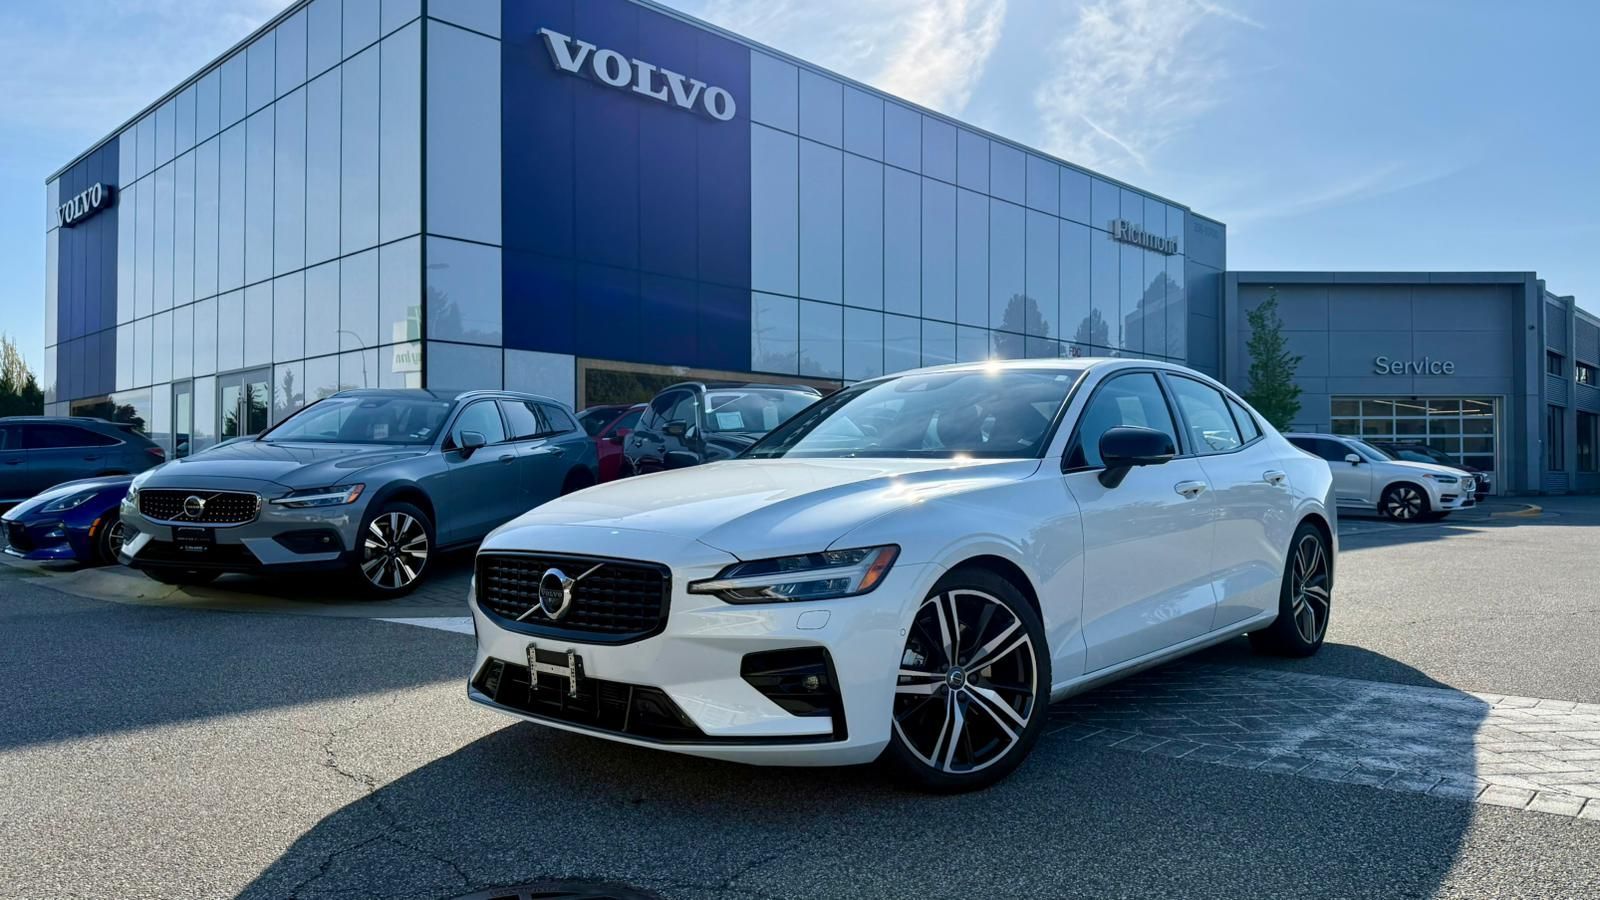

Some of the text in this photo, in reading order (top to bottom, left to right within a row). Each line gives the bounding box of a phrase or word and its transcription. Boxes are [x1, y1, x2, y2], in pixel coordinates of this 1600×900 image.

[538, 27, 737, 122] VOLVO
[57, 182, 103, 228] VOLVO
[1114, 219, 1178, 255] Richmond
[1375, 355, 1456, 375] Service
